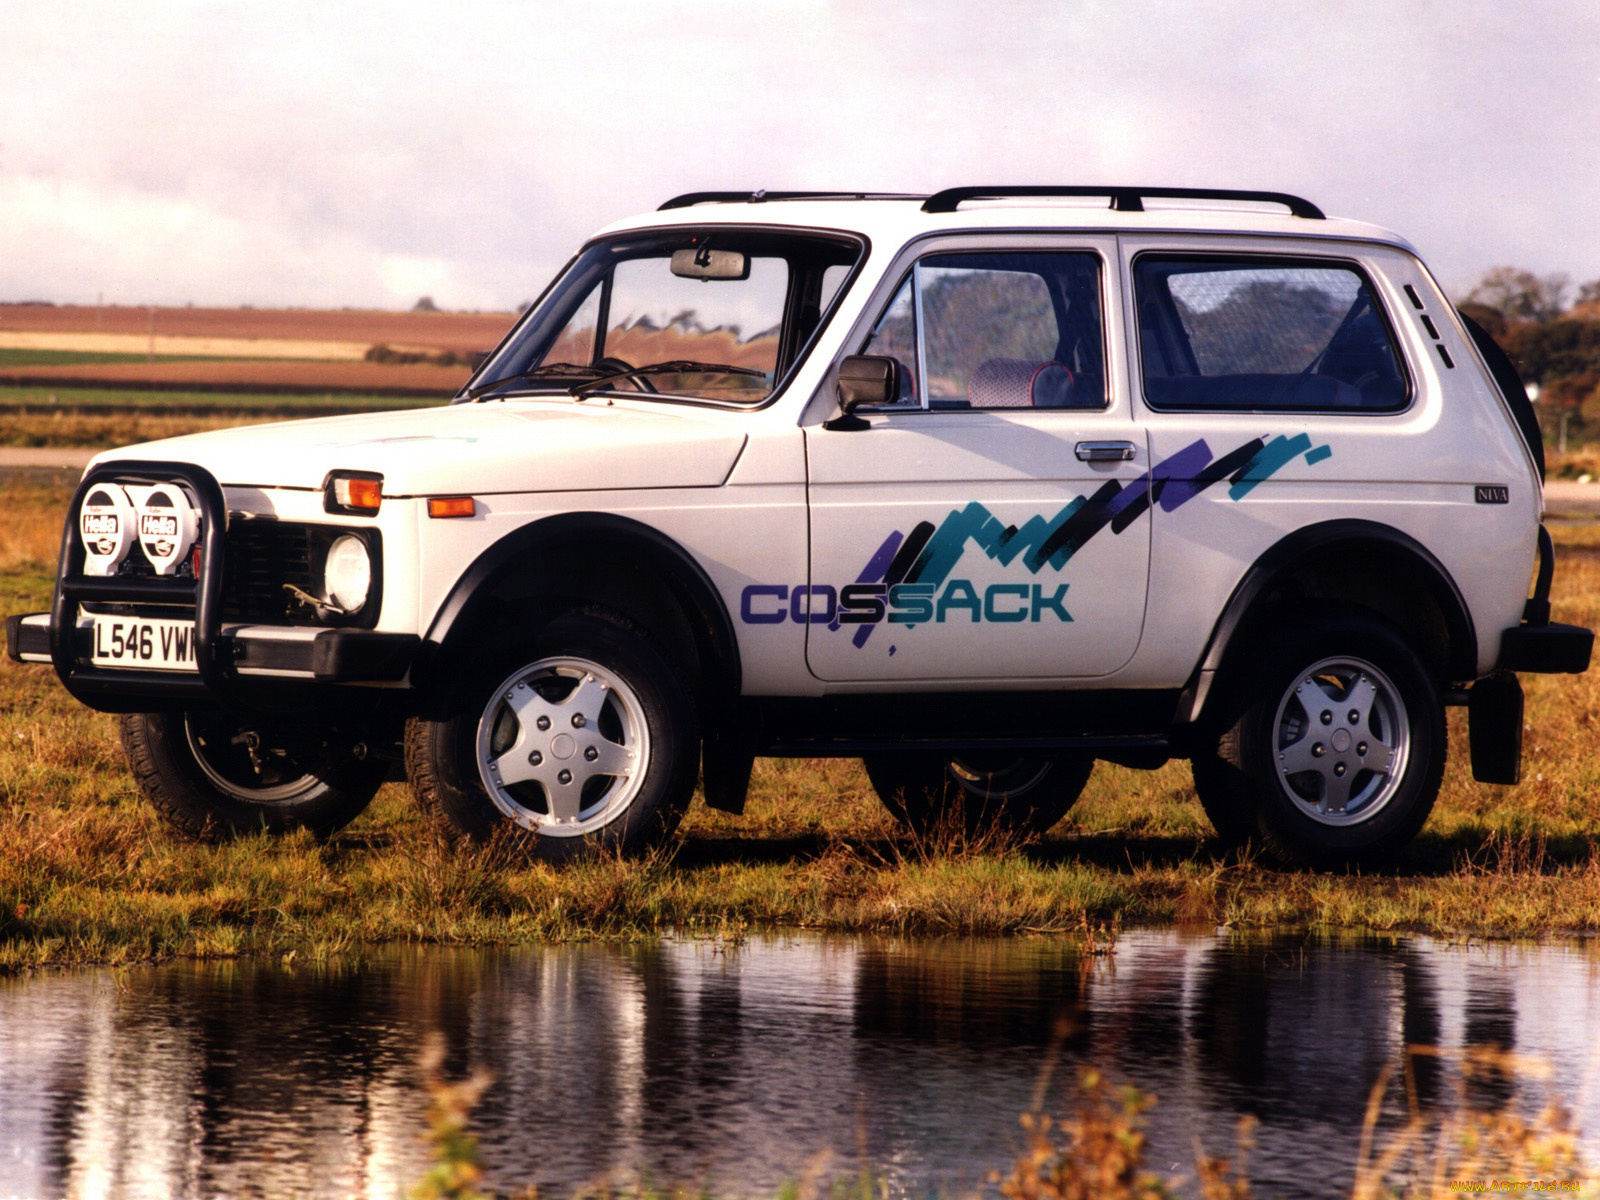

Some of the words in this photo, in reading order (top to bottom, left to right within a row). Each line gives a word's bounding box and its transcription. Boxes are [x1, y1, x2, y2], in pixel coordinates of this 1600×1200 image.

[1478, 488, 1508, 501] NIVA
[85, 515, 117, 533] Hella
[142, 516, 175, 535] Hella
[740, 579, 1075, 625] COSSACK
[96, 623, 153, 660] L546
